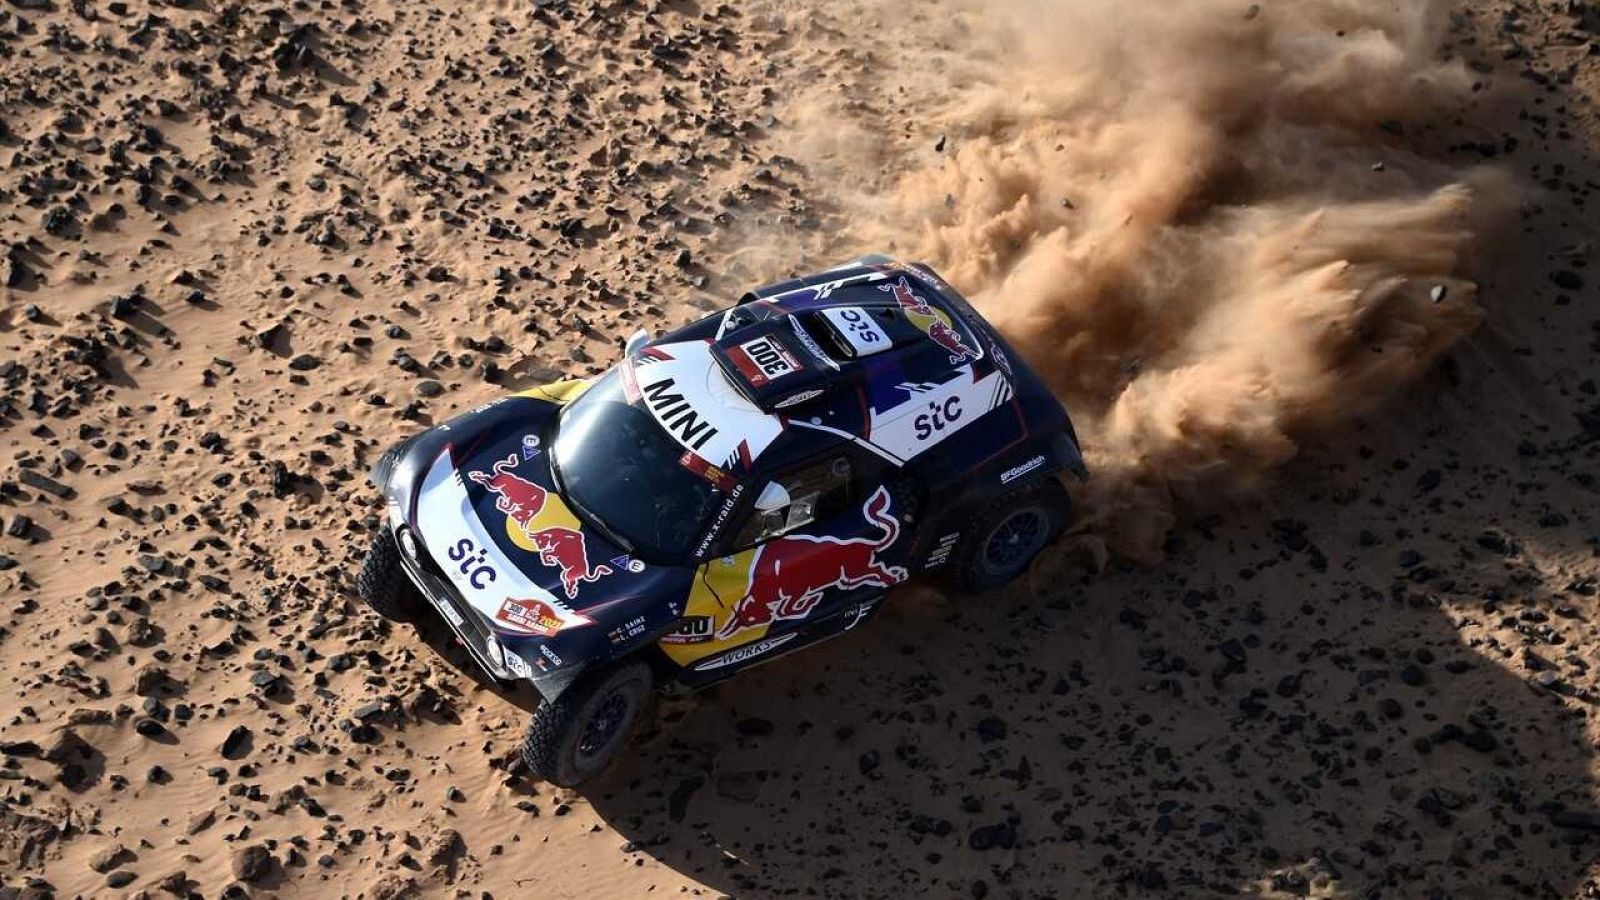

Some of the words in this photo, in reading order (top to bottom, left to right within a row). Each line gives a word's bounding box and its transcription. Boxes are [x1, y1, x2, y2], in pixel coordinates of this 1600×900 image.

[747, 340, 788, 376] 300
[644, 378, 719, 450] MINI
[1000, 455, 1046, 482] BFGoodrich
[696, 484, 744, 556] www.x-raid.de
[722, 640, 772, 663] WORKS
